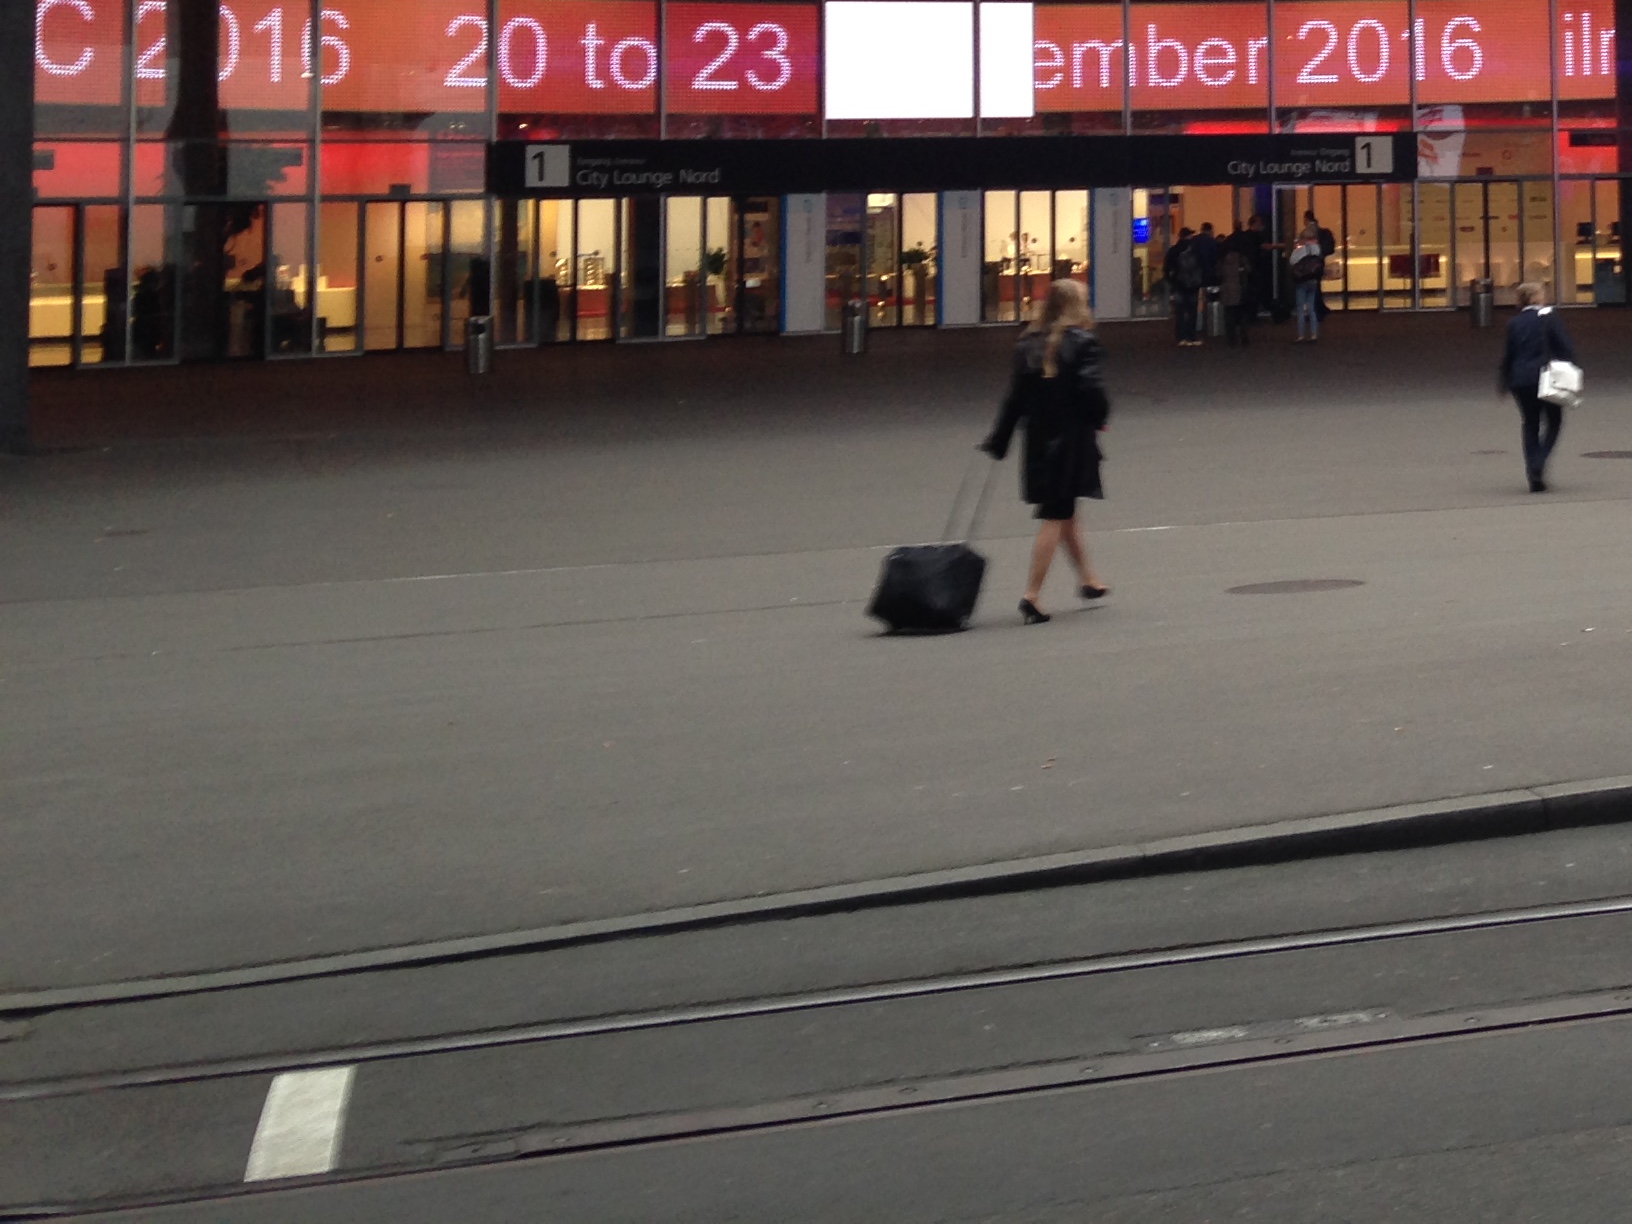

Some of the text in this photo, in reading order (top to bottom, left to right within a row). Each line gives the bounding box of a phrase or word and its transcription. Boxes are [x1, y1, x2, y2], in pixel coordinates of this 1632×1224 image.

[444, 14, 548, 89] 20
[578, 21, 658, 91] to
[691, 20, 792, 91] 23
[1296, 15, 1485, 84] 2016
[531, 150, 546, 182] 1
[1227, 158, 1351, 178] City Lounge Nord
[1360, 141, 1373, 169] 1
[575, 167, 721, 189] City Lounge Nord
